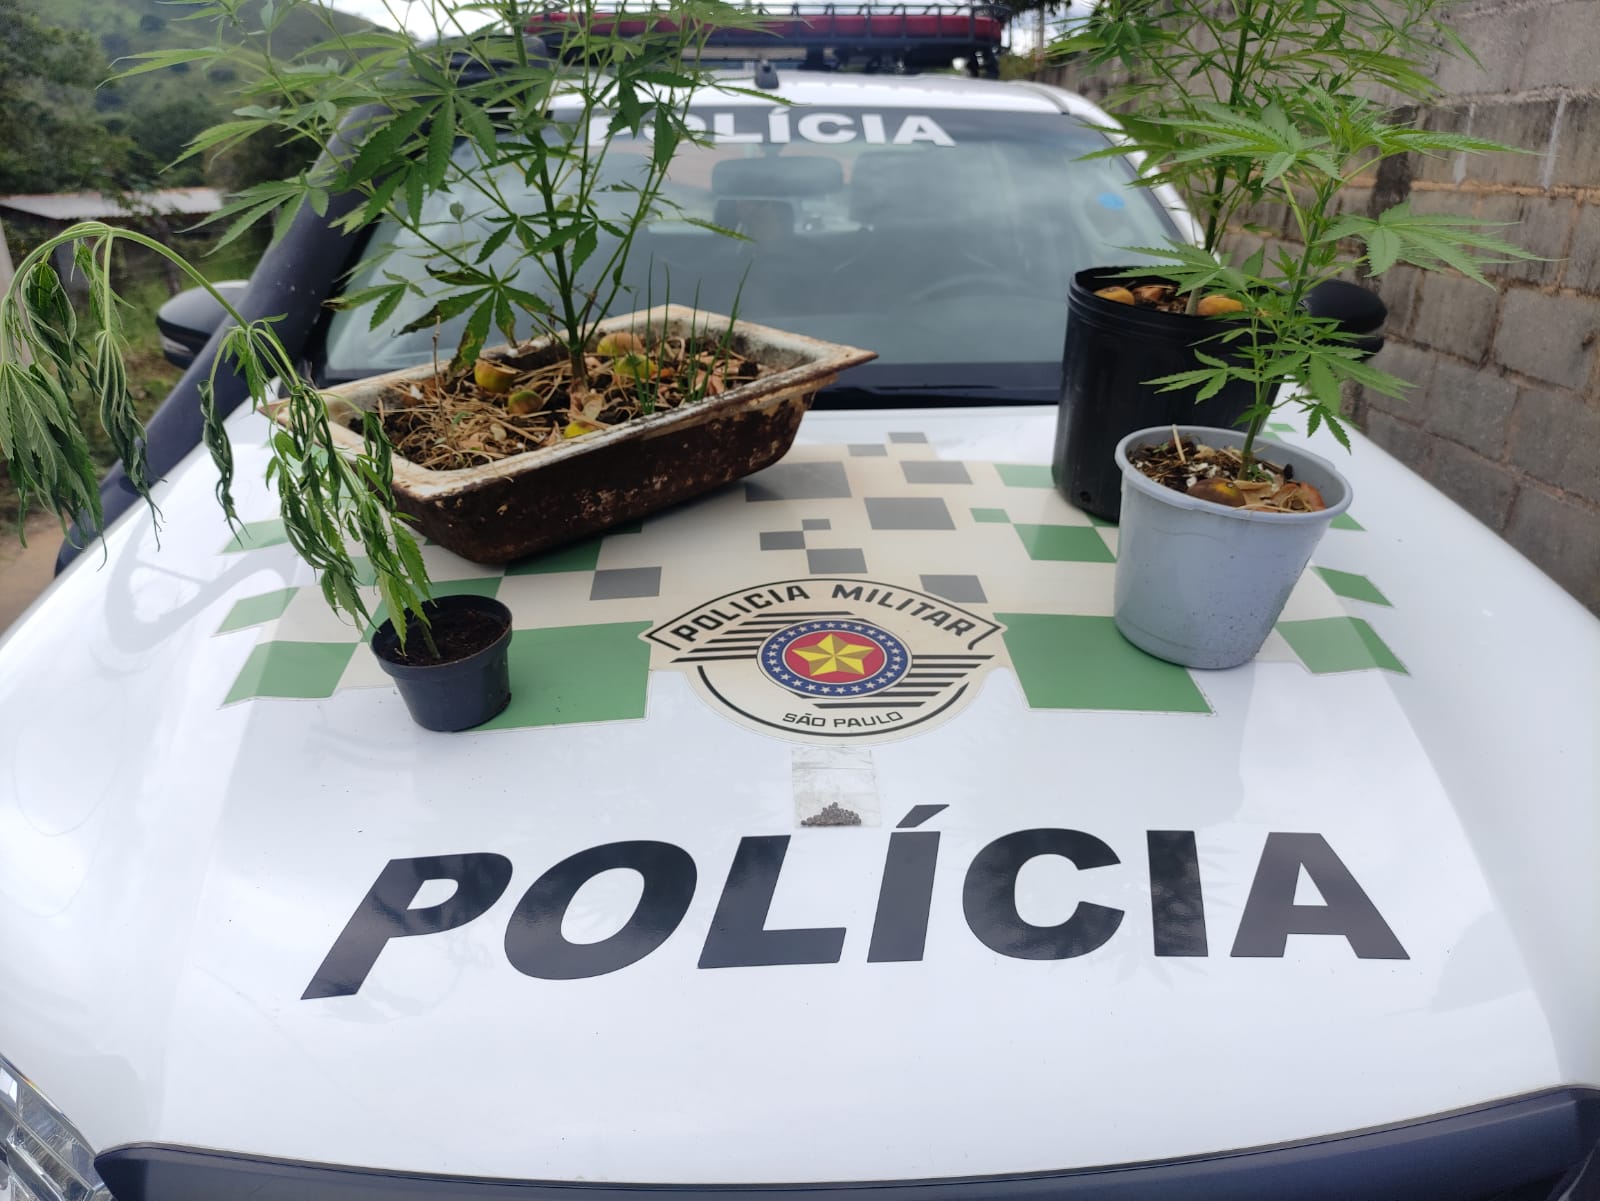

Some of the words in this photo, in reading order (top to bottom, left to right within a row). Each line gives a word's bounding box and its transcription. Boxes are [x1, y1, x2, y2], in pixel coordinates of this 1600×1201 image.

[670, 585, 810, 642] POLICIA
[831, 584, 976, 637] MILITAR
[782, 712, 826, 727] SÃO
[833, 711, 903, 728] PAULO
[300, 804, 1410, 1000] POLÍCIA
